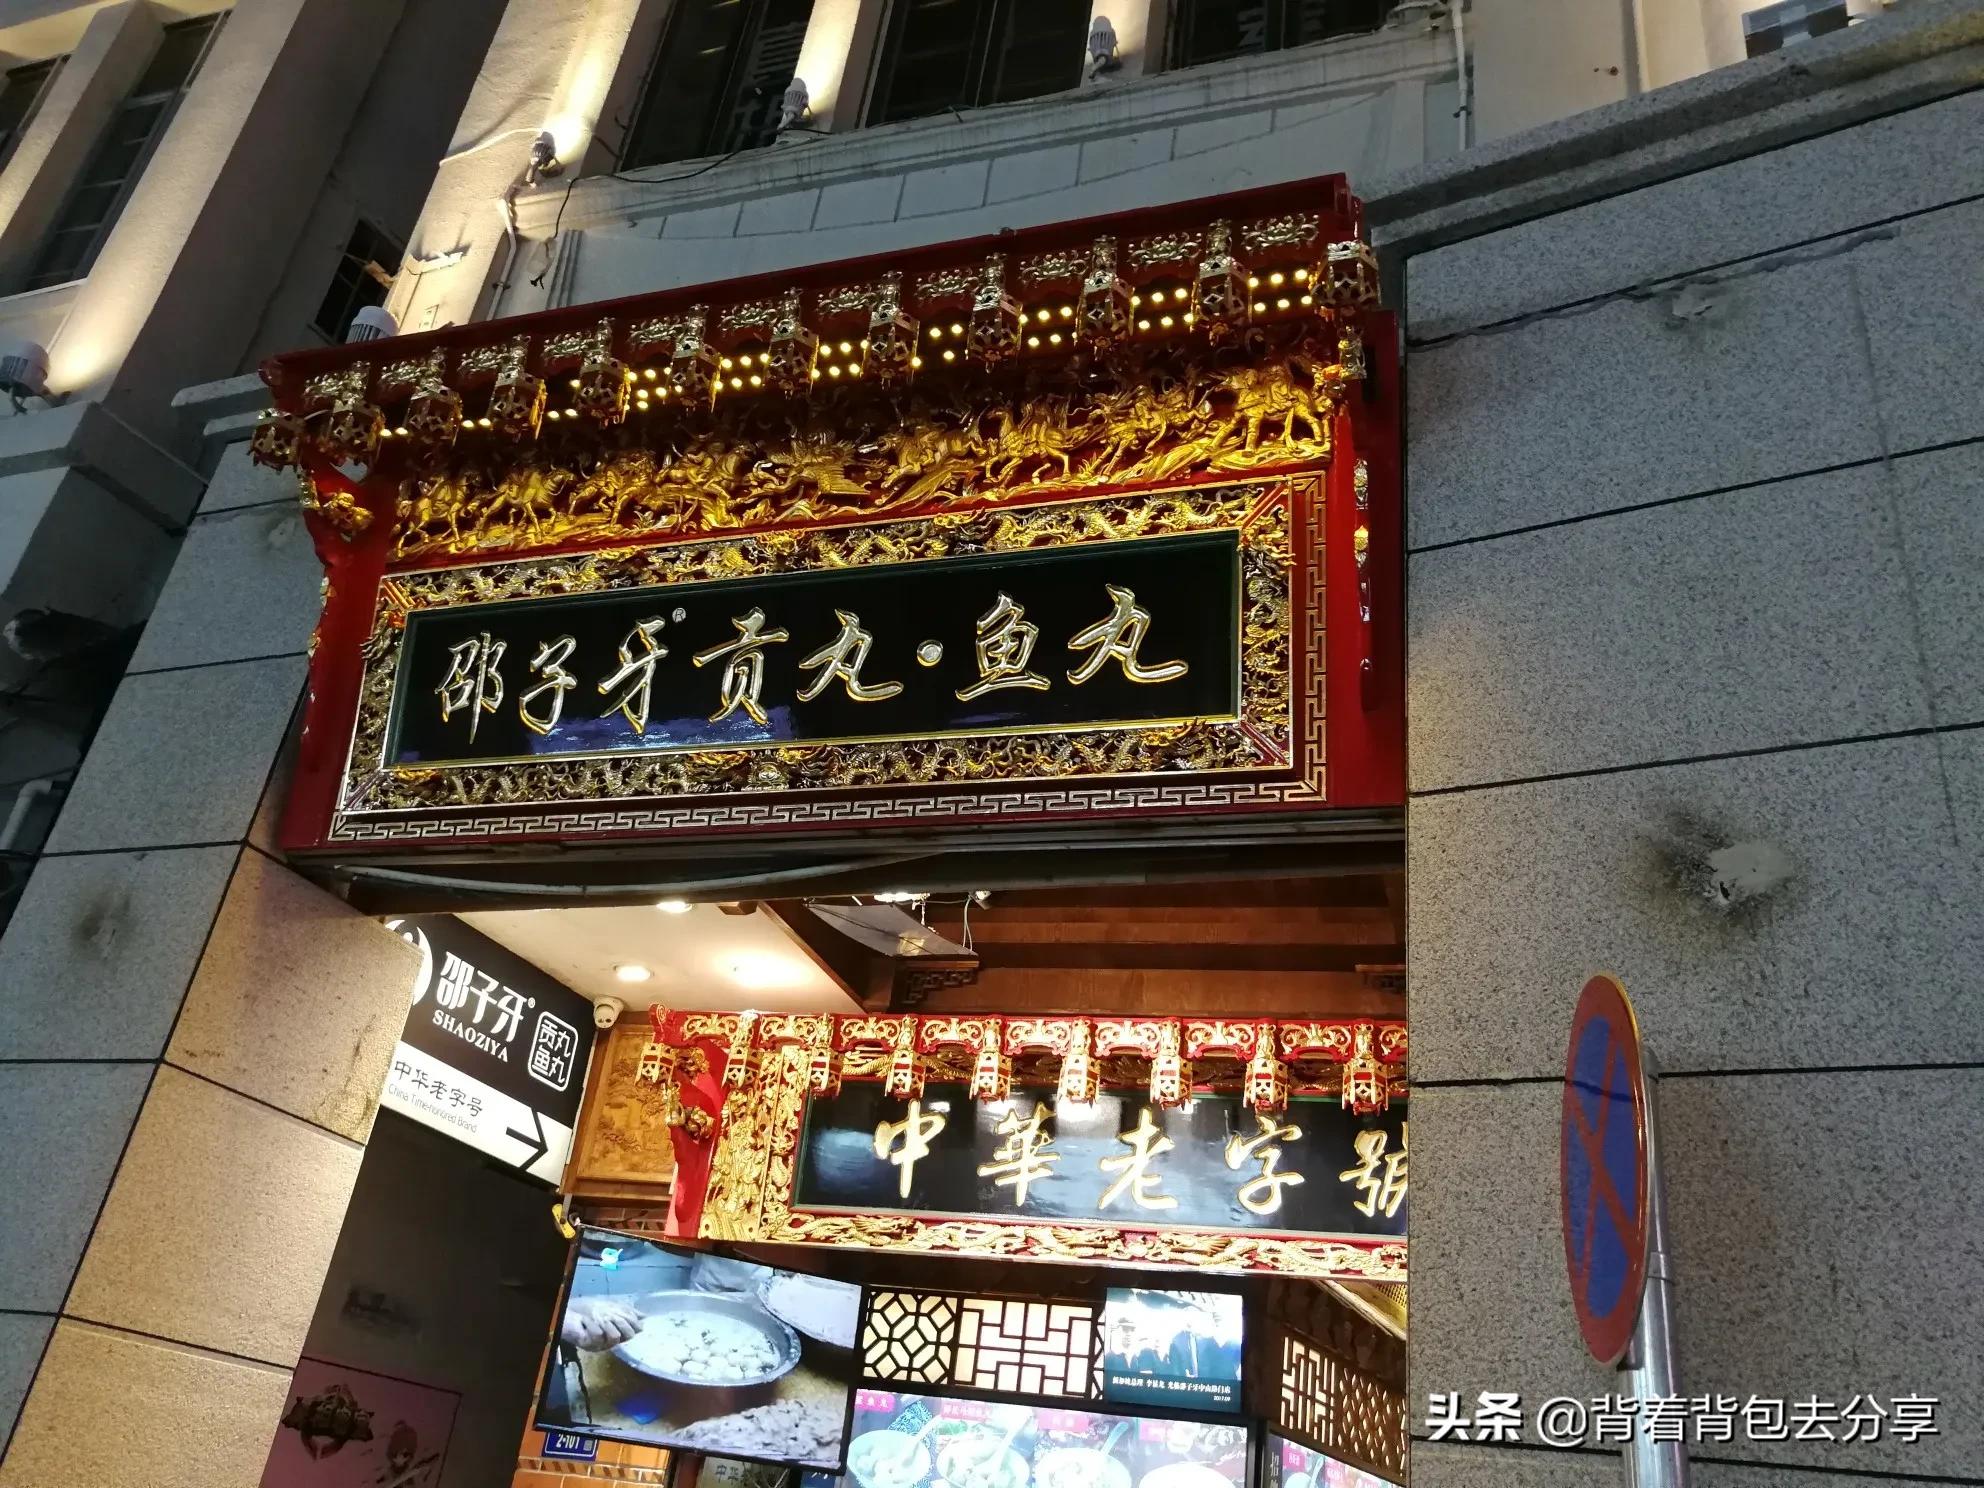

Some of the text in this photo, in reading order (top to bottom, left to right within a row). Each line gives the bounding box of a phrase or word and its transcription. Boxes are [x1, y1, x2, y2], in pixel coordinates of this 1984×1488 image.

[436, 951, 528, 1043] 邵子牙
[432, 1009, 508, 1063] SHAOZIYA
[388, 1083, 409, 1102] China
[457, 1116, 478, 1134] Brand
[394, 1060, 483, 1118] 中华老字号
